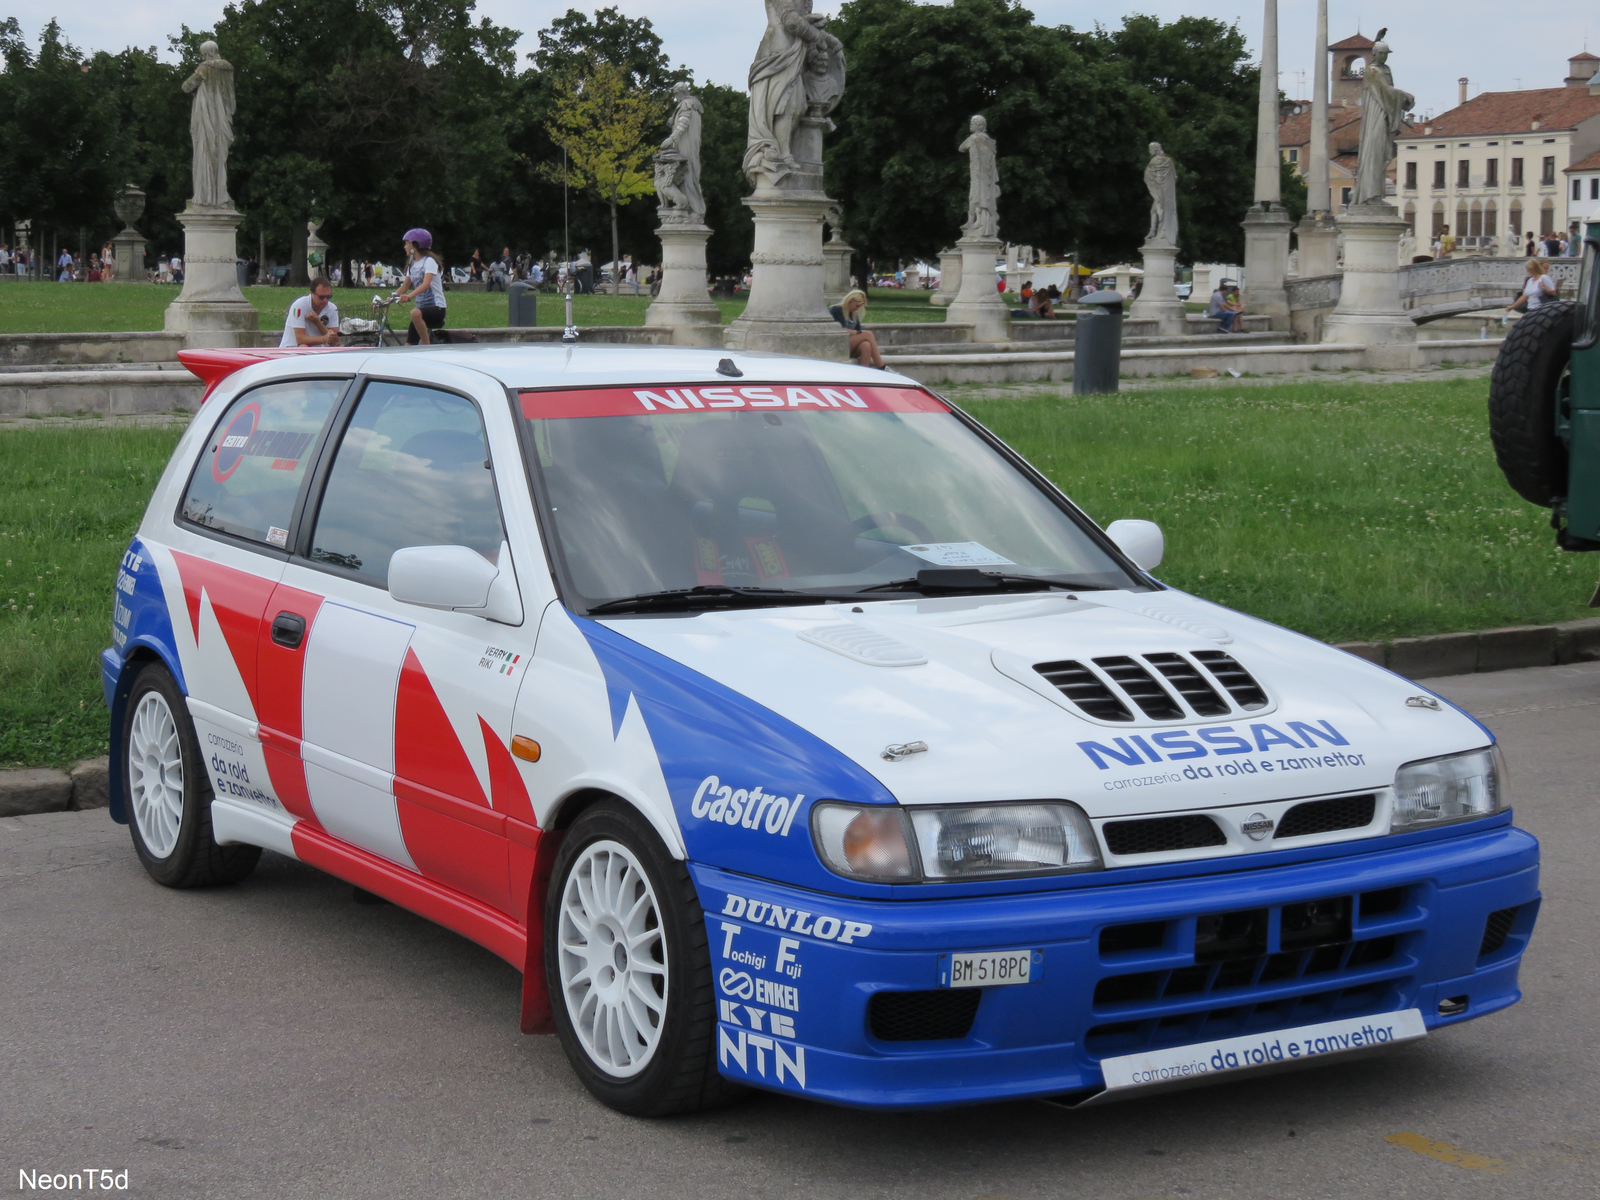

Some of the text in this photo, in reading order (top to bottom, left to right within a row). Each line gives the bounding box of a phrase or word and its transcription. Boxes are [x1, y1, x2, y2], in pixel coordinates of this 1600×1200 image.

[633, 387, 868, 411] NISSAN
[478, 657, 494, 669] RIKI
[485, 645, 508, 660] VERRY
[207, 733, 244, 756] carrozzeria
[1076, 719, 1350, 770] NISSAN
[211, 752, 250, 784] da rold
[1103, 751, 1367, 791] carrozzeria da rold e zanvettor
[217, 777, 279, 810] e zanvettor
[690, 775, 806, 837] Castrol
[1243, 820, 1274, 831] NISSAN
[721, 893, 873, 944] DUNLOP
[720, 921, 803, 980] Tochigi Fuji
[755, 983, 799, 1012] ENKEI
[720, 1000, 796, 1039] KYB
[719, 1026, 807, 1090] NTN
[1132, 1024, 1395, 1084] carrozzeria da rold e zanvettor
